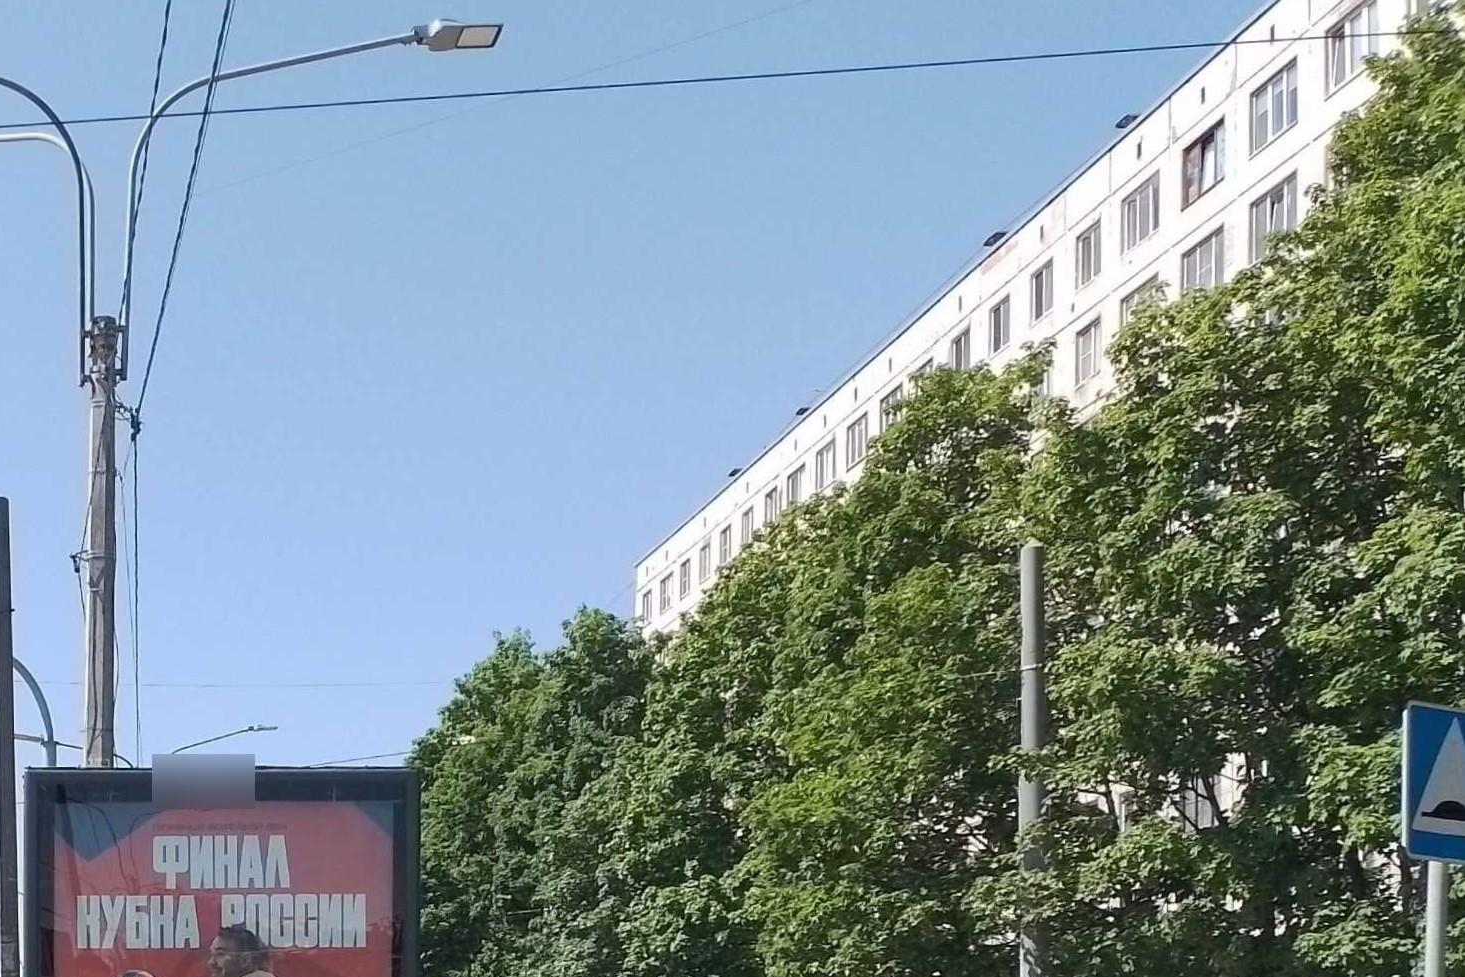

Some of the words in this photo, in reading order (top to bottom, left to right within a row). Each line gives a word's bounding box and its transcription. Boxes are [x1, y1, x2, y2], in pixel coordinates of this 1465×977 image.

[152, 834, 291, 890] ФИНАЛ
[76, 894, 201, 949] КУБКА
[221, 893, 367, 948] РОССИИ
